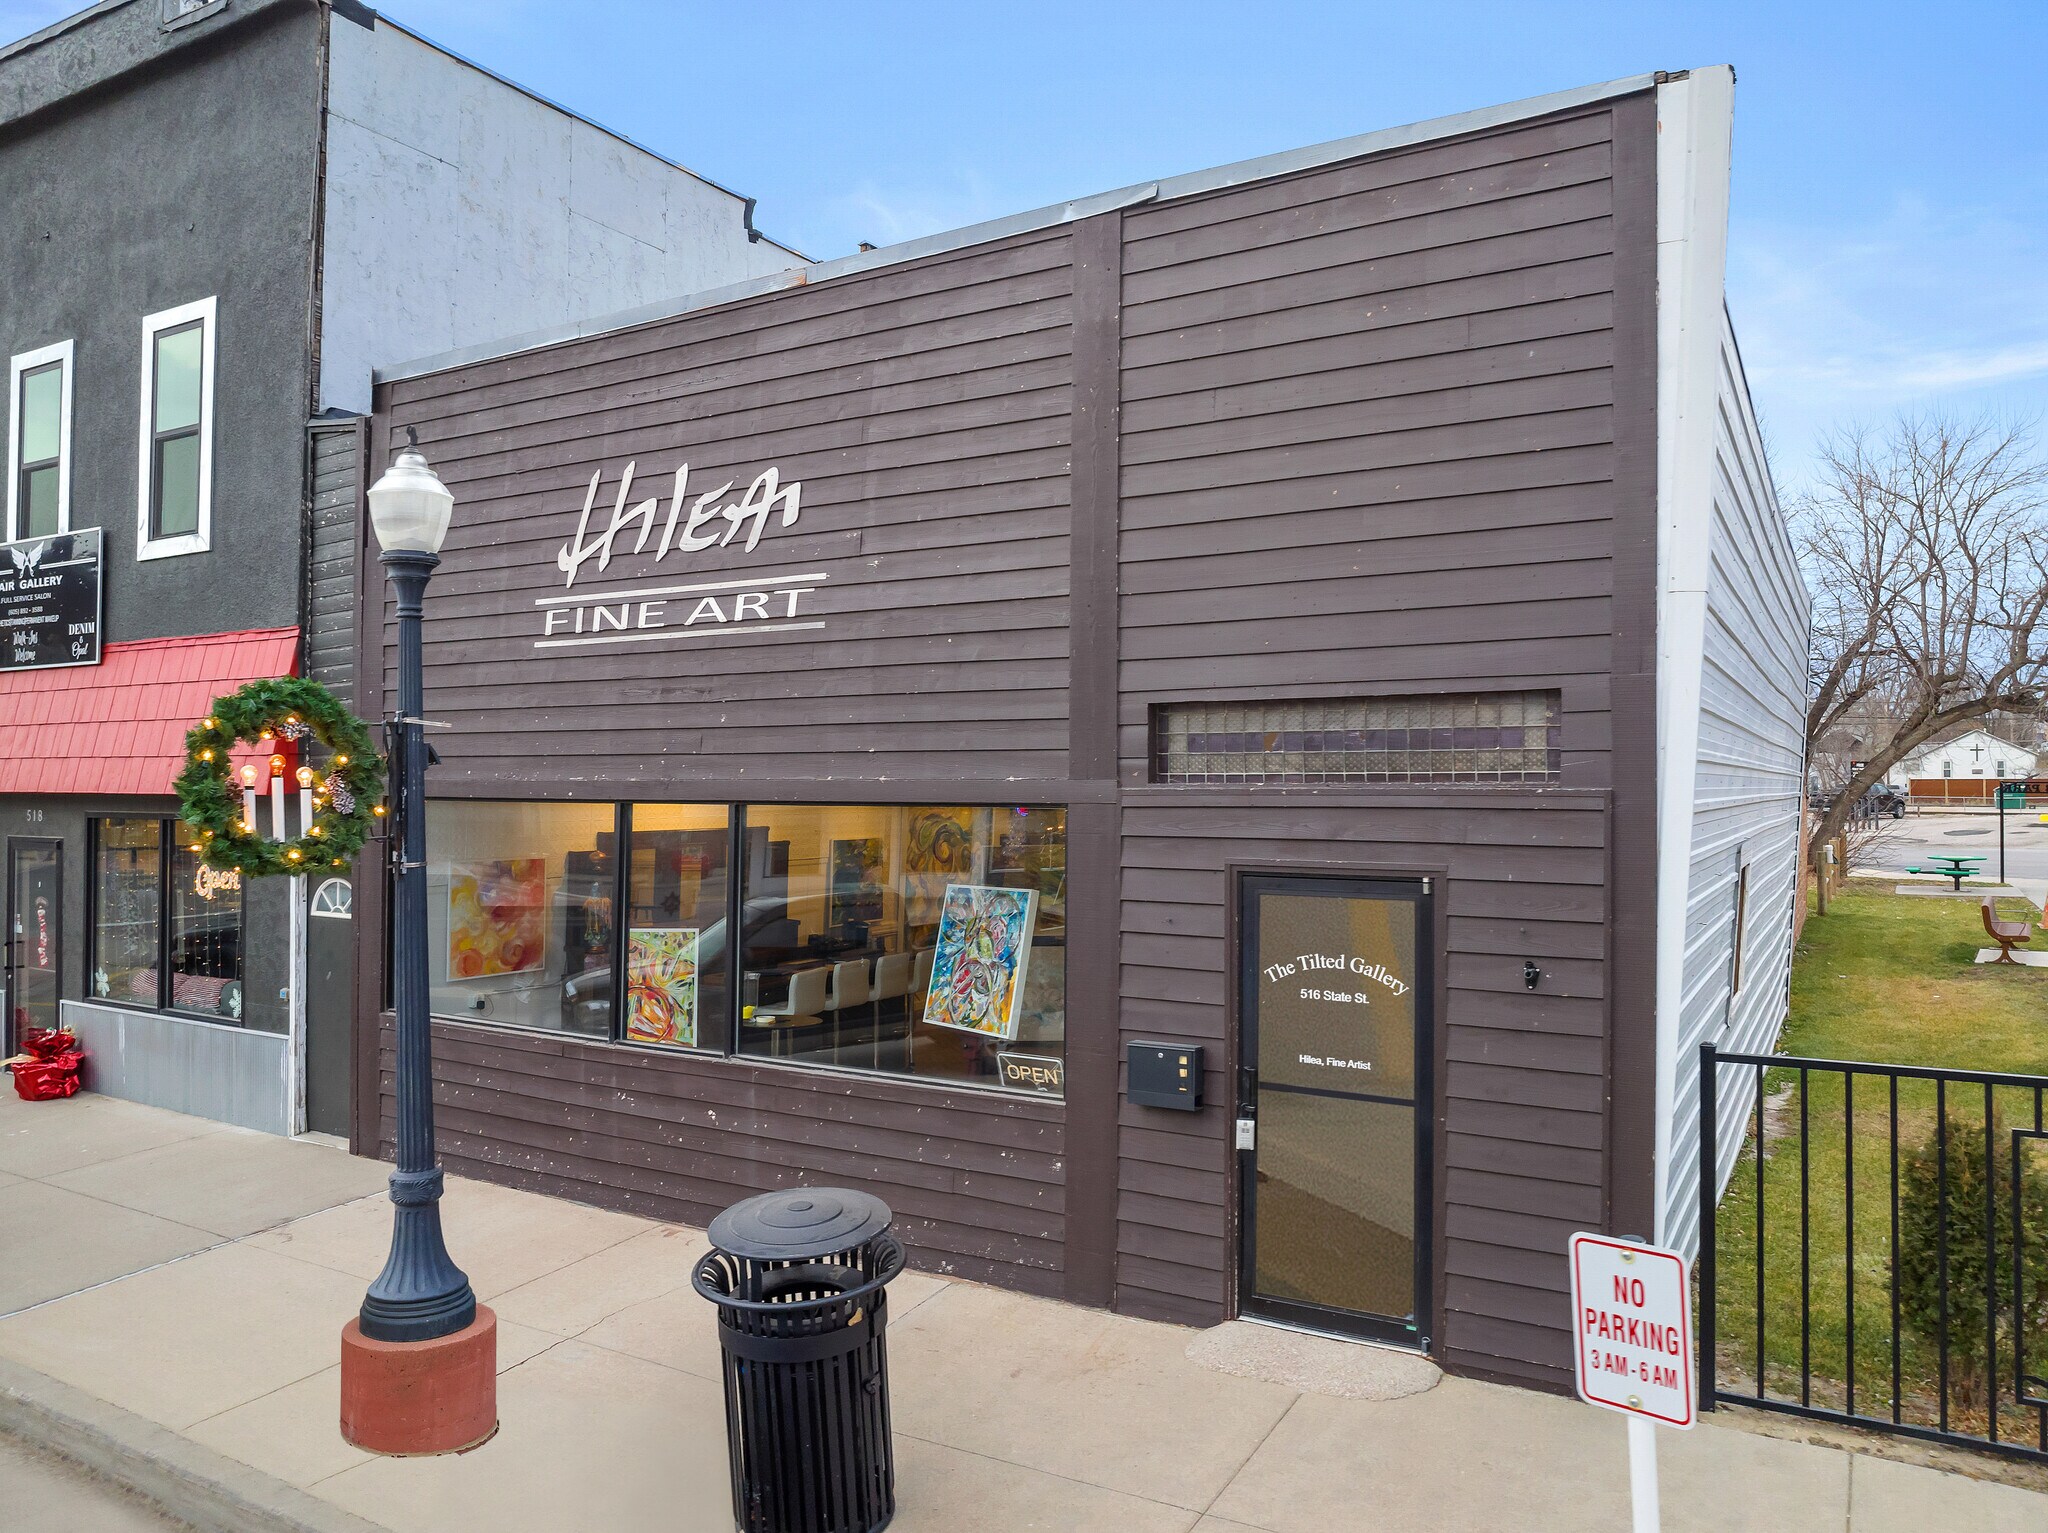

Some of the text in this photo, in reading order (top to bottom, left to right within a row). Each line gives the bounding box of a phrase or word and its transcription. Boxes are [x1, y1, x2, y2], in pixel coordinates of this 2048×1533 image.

[19, 575, 63, 590] GALLERY
[13, 594, 33, 603] SERVICE
[34, 592, 52, 601] SALON
[544, 588, 815, 636] FINE ART
[68, 622, 95, 636] DENIM
[26, 809, 43, 822] 518
[195, 864, 241, 900] Open
[1263, 953, 1410, 996] The Tilted Gallery
[1300, 988, 1370, 1004] 516 State St.
[1299, 1054, 1372, 1071] Hilea, Fine Artist
[1007, 1064, 1059, 1085] OPEN
[1613, 1274, 1645, 1308] NO
[1585, 1307, 1680, 1356] PARKING
